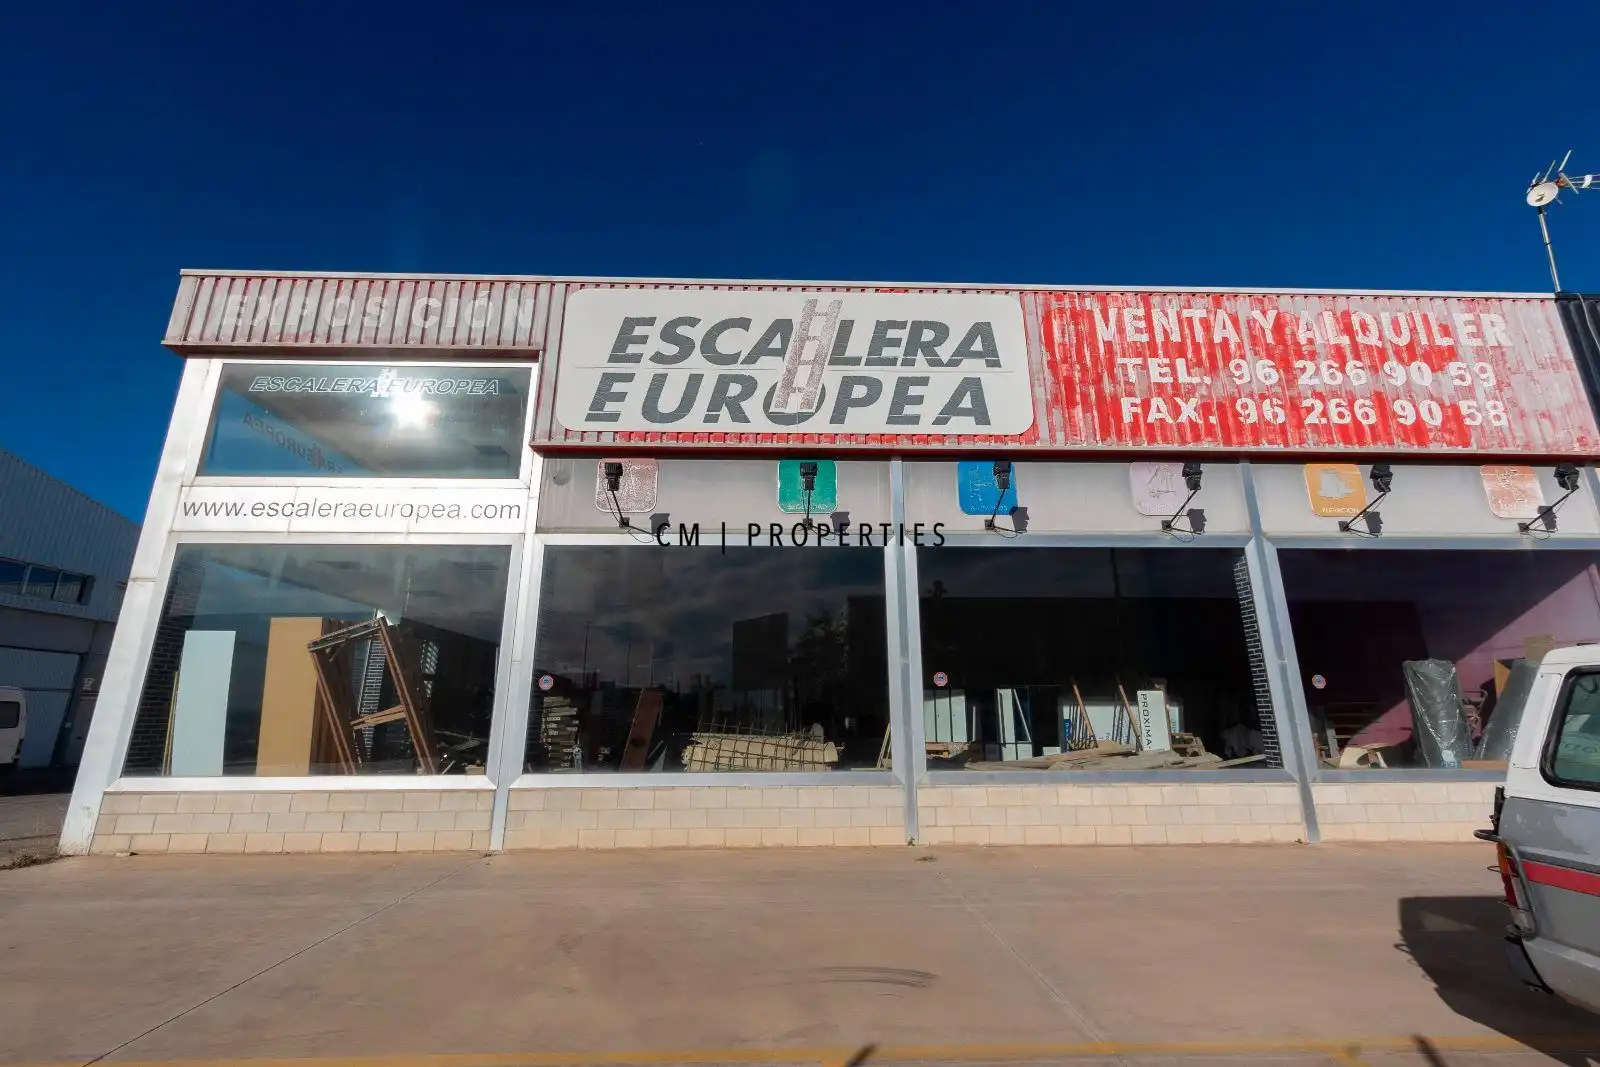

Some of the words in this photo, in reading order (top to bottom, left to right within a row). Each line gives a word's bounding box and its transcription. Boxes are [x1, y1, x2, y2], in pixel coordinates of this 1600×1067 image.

[606, 316, 1002, 368] ESCALERA
[1095, 308, 1241, 345] VENTA
[1252, 310, 1279, 344] Y
[1297, 311, 1513, 348] ALQUILER
[249, 377, 380, 394] ESCALERA
[386, 379, 499, 395] EUROPEA
[1117, 357, 1212, 385] TEL.
[1229, 358, 1280, 385] 96
[1297, 360, 1369, 387] 266
[1384, 361, 1433, 387] 90
[1451, 361, 1497, 388] 59
[584, 372, 993, 426] EUROPEA
[1121, 397, 1218, 425] FAX.
[1236, 397, 1287, 425] 96
[1304, 399, 1377, 425] 266
[1393, 399, 1444, 426] 90
[1462, 399, 1509, 427] 58
[183, 498, 521, 523] www.escaleraeuropea.com
